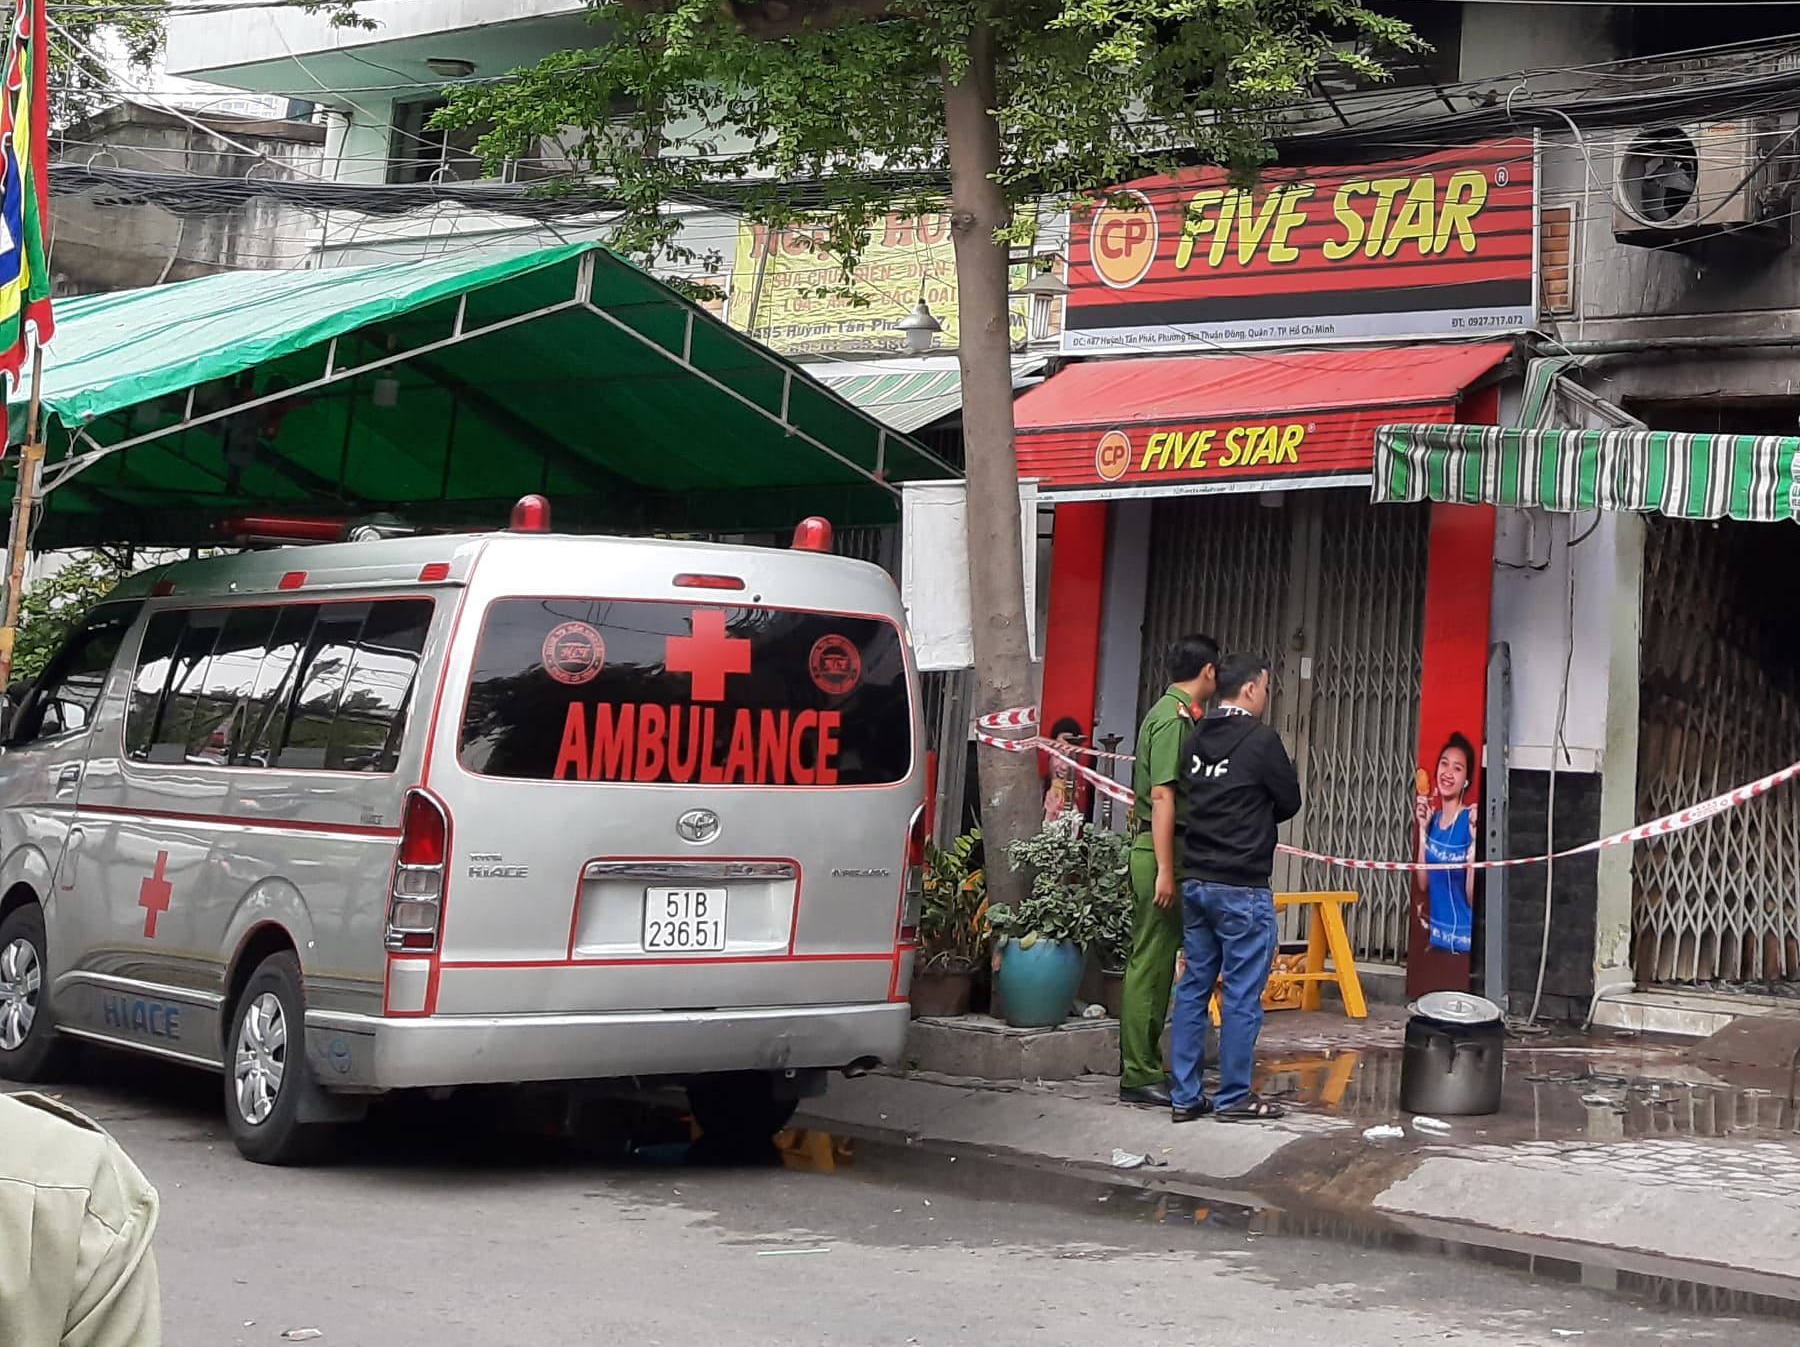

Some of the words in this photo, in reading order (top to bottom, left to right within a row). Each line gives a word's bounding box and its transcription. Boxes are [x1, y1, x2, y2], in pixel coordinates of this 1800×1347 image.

[1099, 218, 1147, 260] CP
[1175, 182, 1316, 271] FIVE
[1323, 170, 1489, 261] STAR
[1099, 444, 1125, 467] CP
[1140, 430, 1217, 472] FIVE
[1219, 424, 1305, 468] STAR
[552, 701, 842, 786] AMBULANCE
[666, 892, 707, 919] 51B
[648, 920, 719, 948] 236.51
